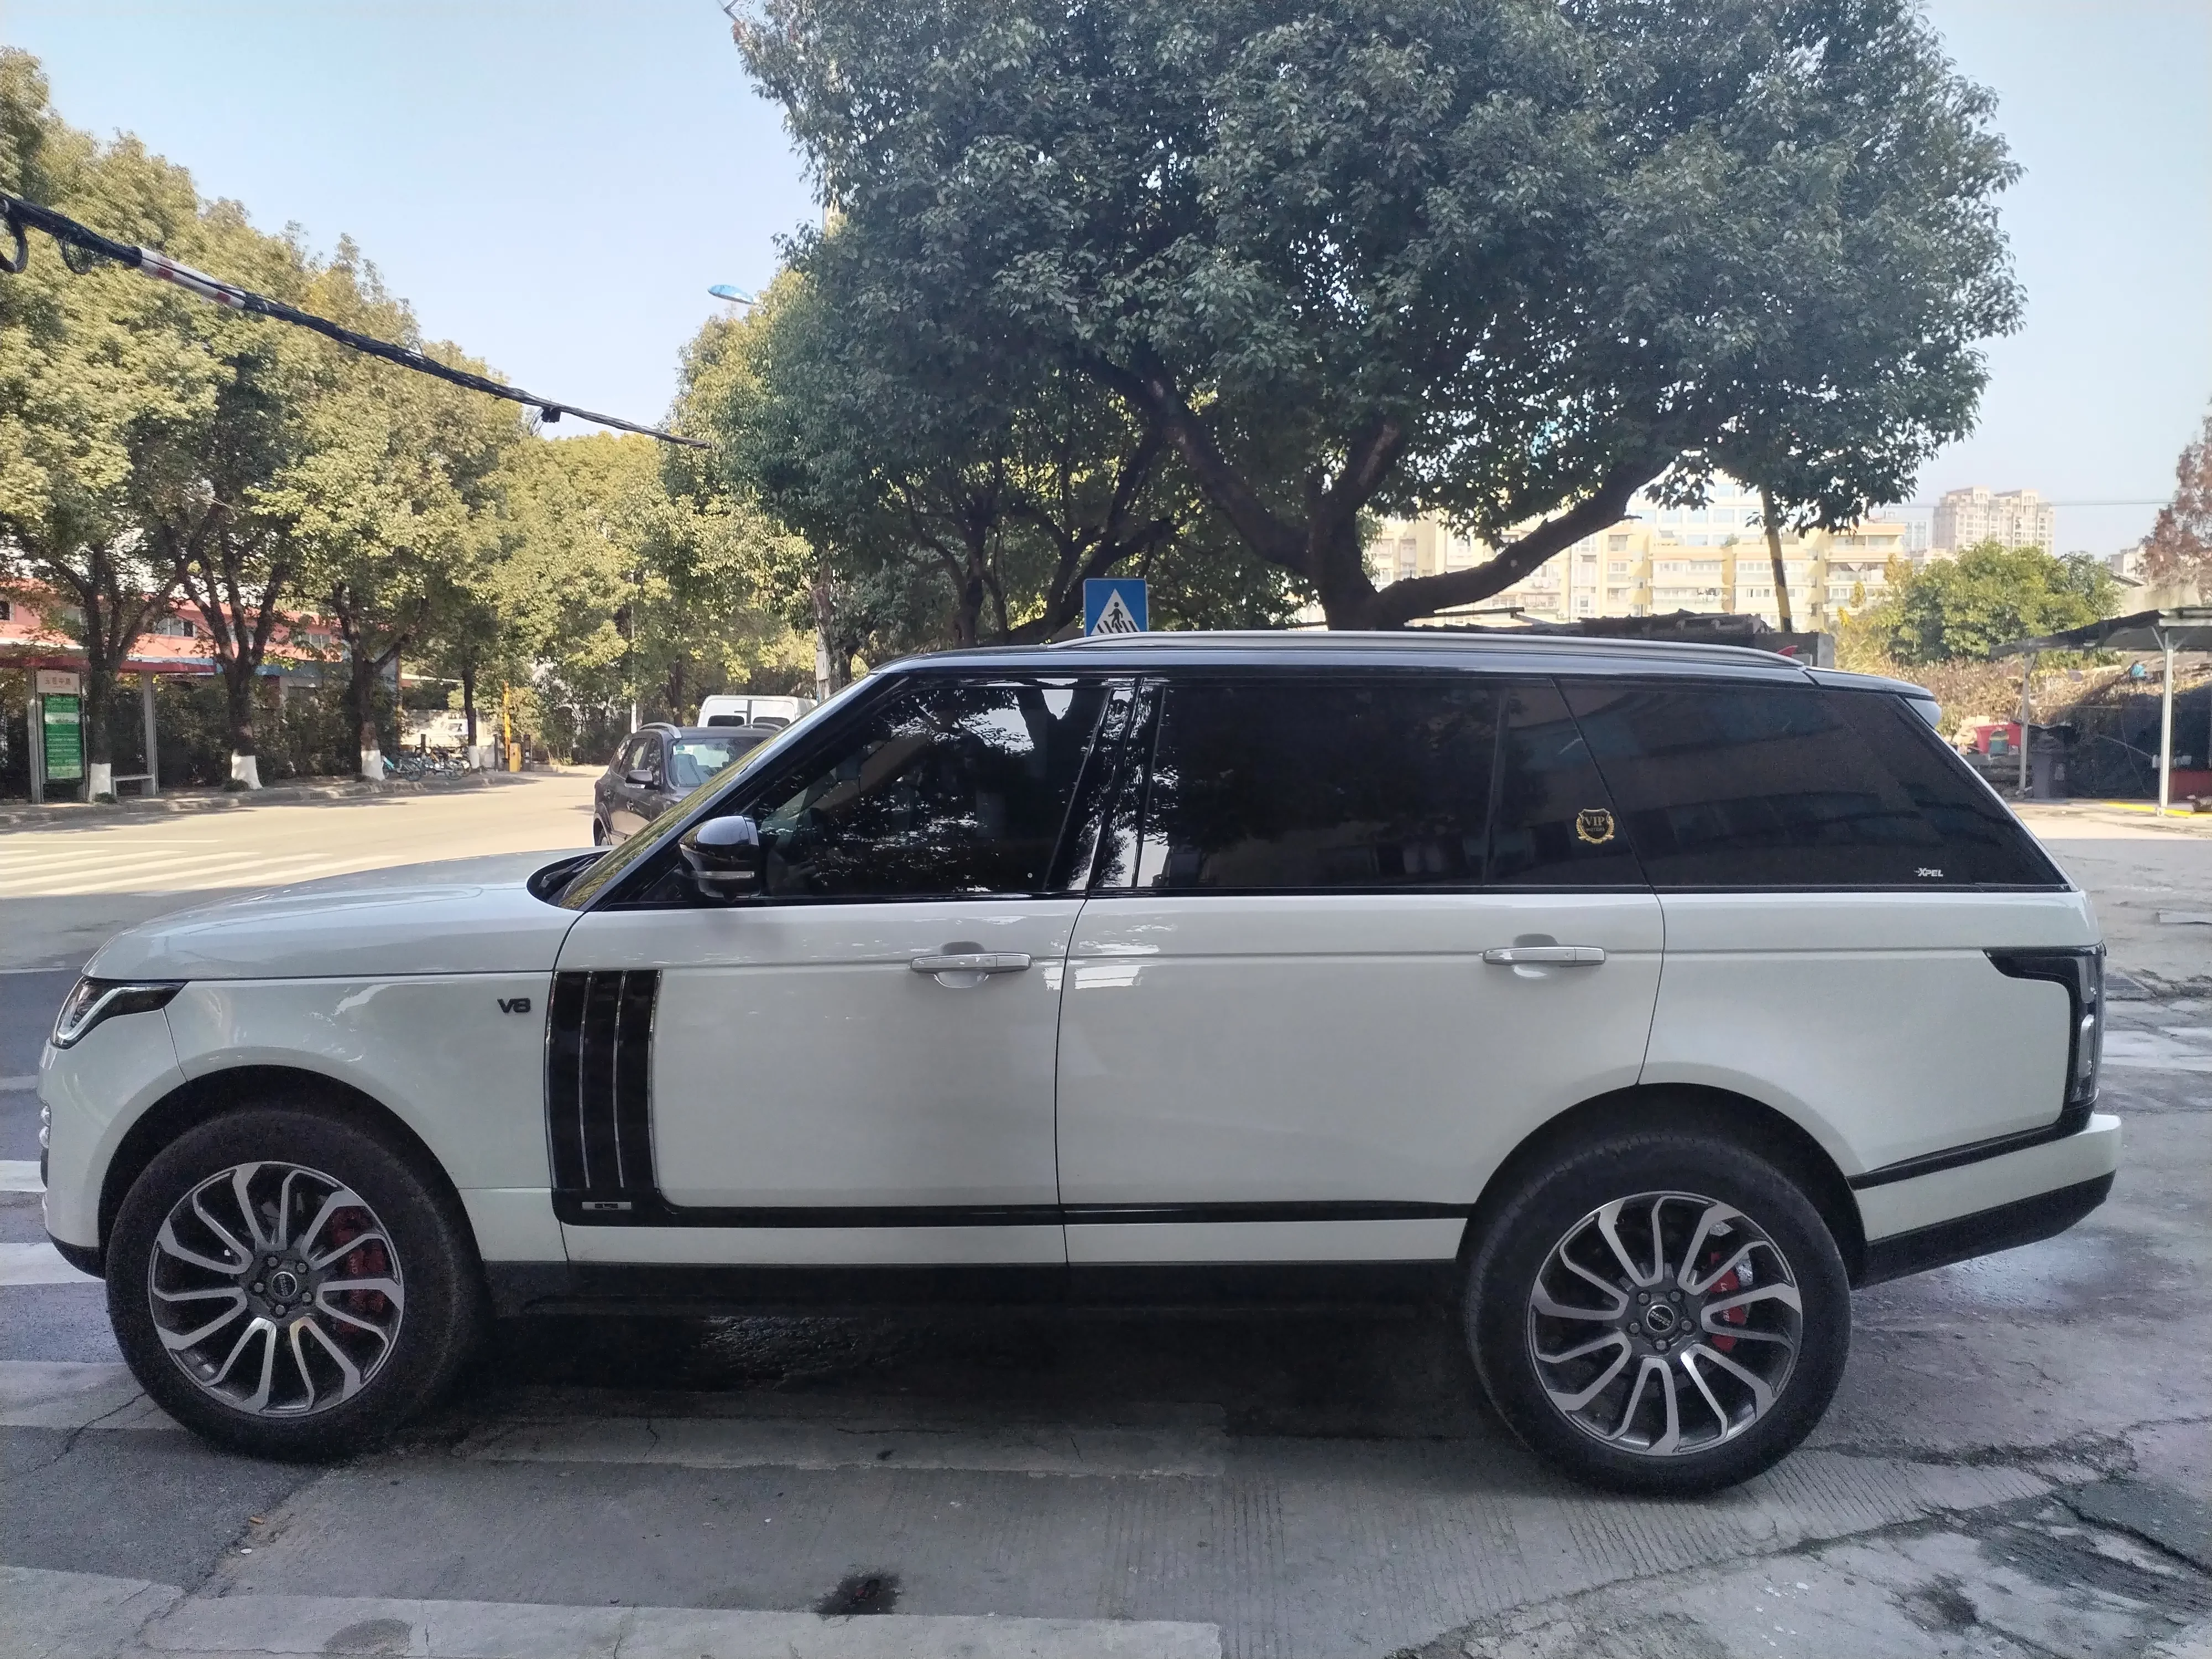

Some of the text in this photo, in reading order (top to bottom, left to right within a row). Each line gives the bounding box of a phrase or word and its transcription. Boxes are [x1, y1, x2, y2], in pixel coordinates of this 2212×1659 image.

[1584, 816, 1605, 826] VIP
[1917, 867, 1944, 877] XPEL
[497, 998, 531, 1013] V8
